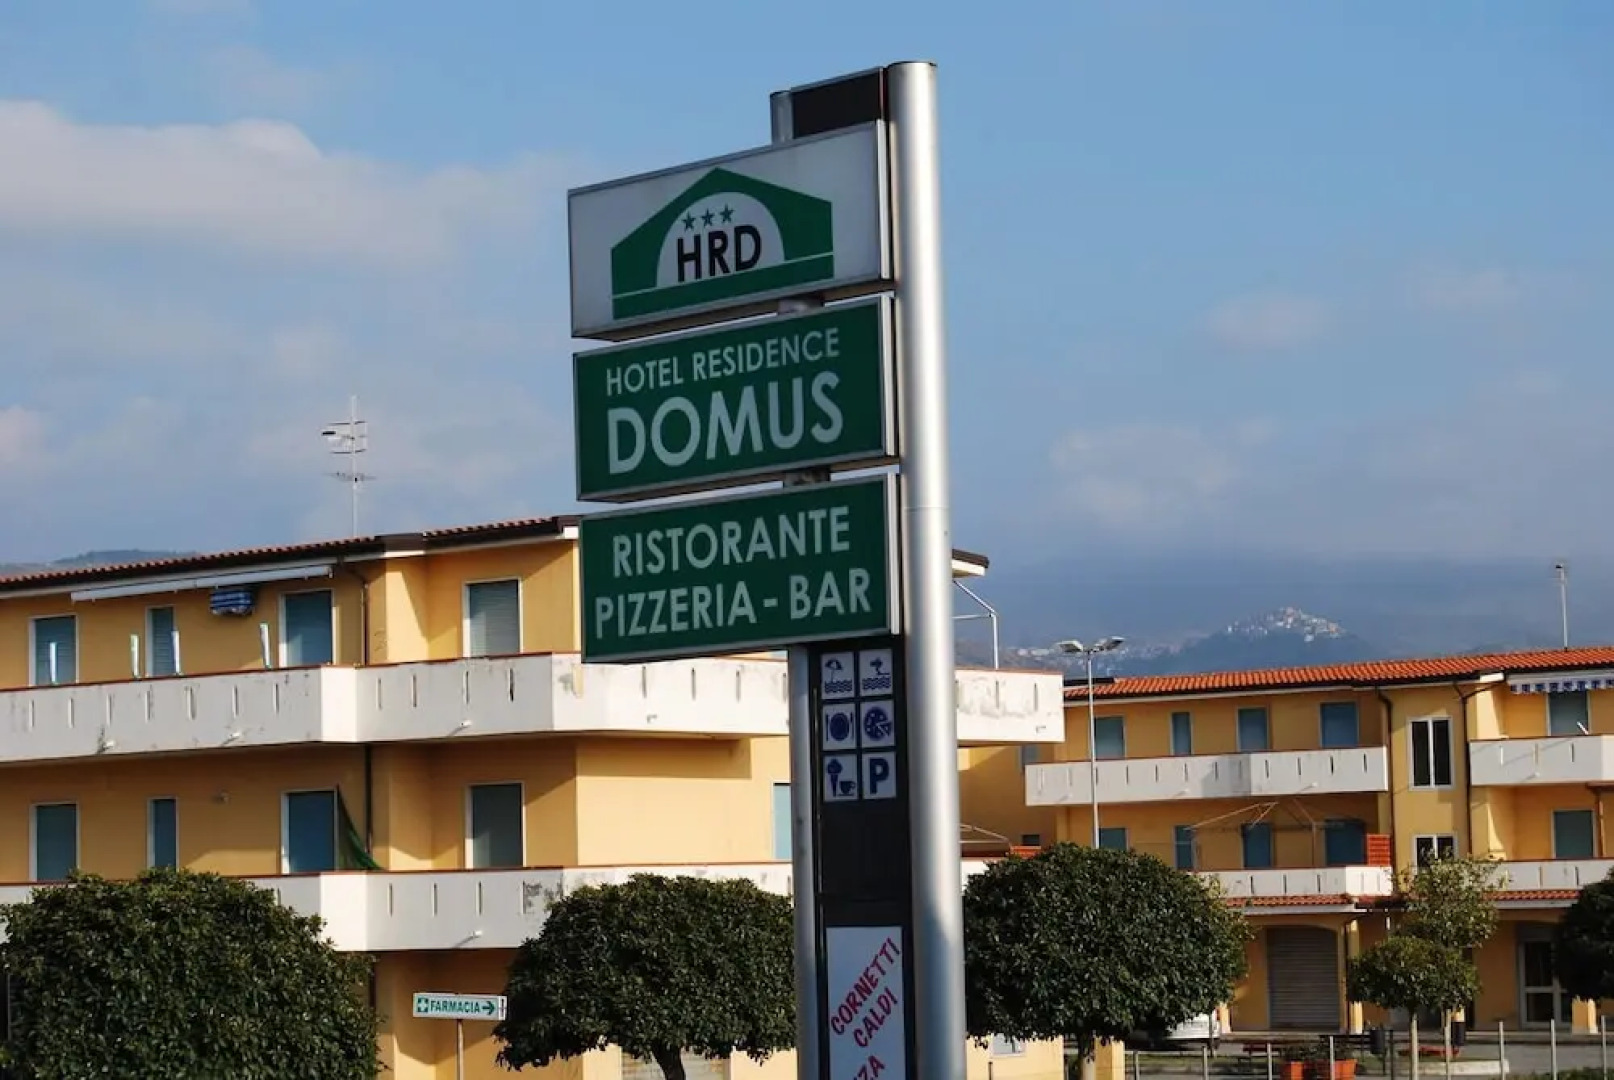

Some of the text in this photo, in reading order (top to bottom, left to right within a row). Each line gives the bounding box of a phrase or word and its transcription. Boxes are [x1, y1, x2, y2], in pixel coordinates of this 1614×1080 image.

[677, 225, 761, 282] HRD
[606, 327, 840, 396] HOTEL RESIDENCE
[607, 370, 844, 475] DOMUS
[612, 505, 850, 578] RISTORANTE
[595, 580, 757, 639] PIZZERIA
[789, 567, 871, 620] BAR
[430, 1000, 480, 1013] FARMACIA
[831, 937, 901, 1036] CORNETTI
[853, 986, 898, 1048] CALDI
[853, 1055, 885, 1080] ZA
